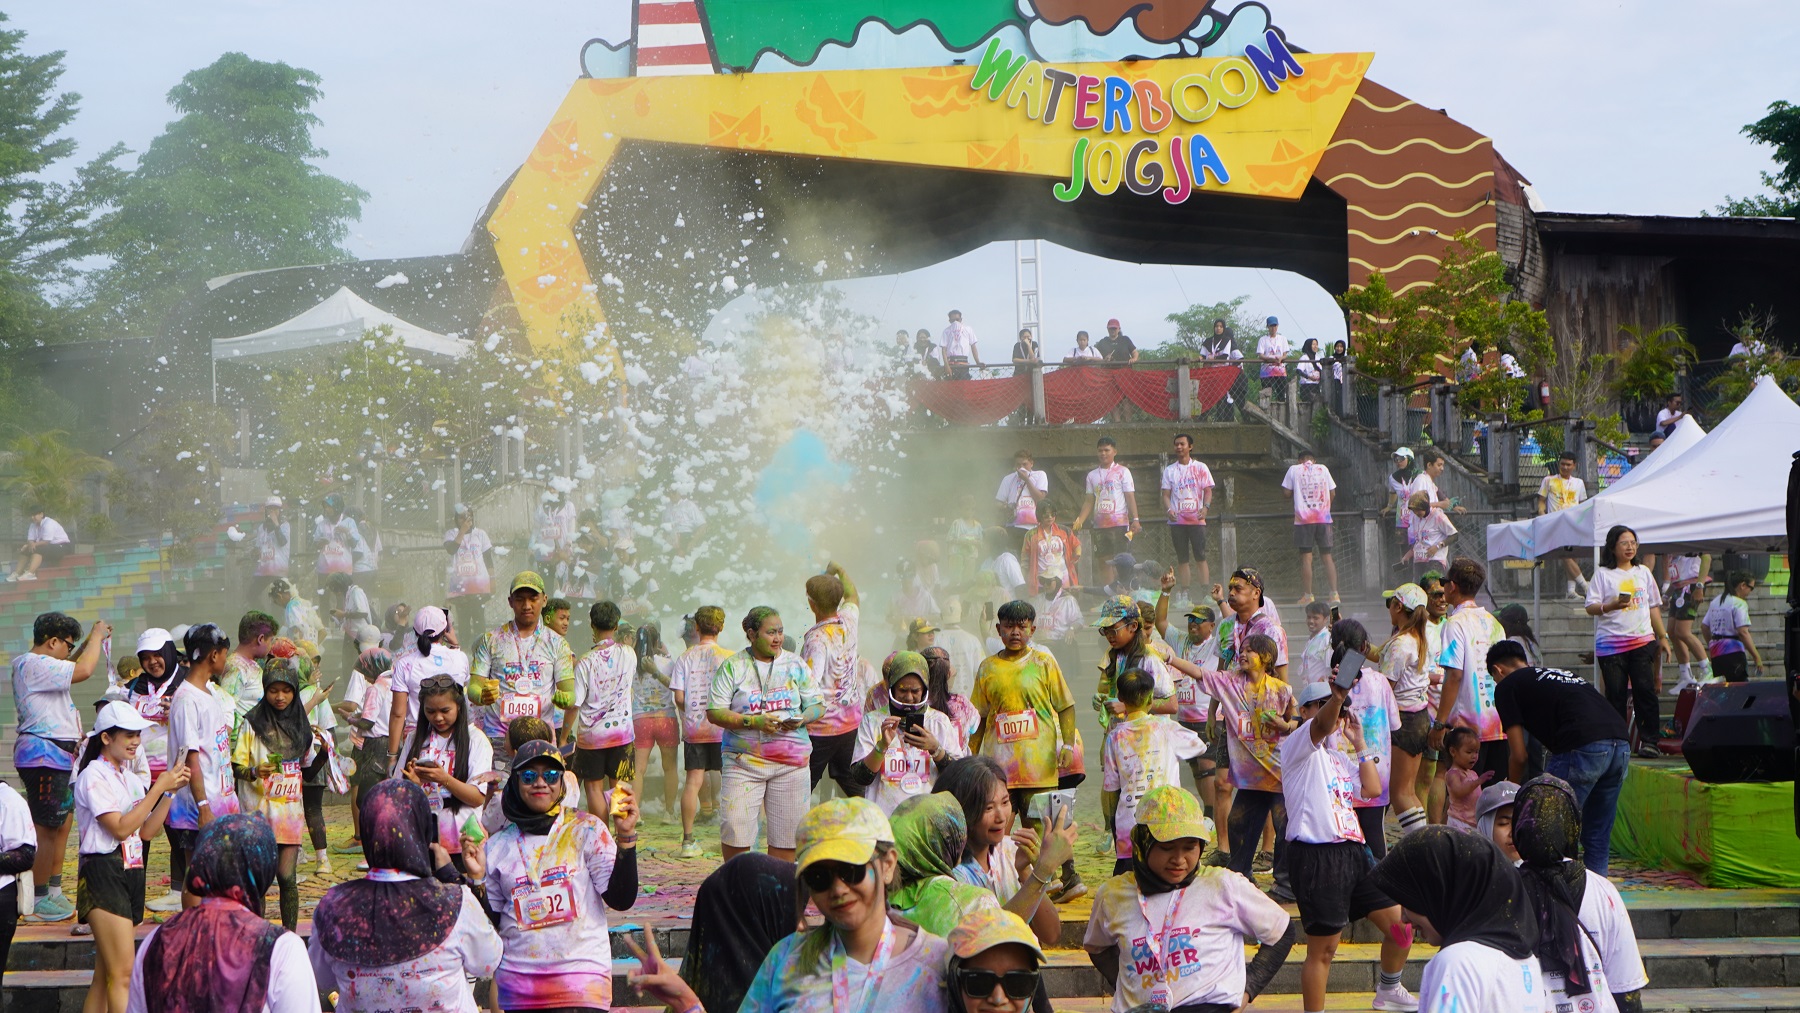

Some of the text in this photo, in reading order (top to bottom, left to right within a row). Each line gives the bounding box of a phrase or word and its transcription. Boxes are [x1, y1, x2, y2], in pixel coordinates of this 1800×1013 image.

[971, 29, 1305, 133] WATERBOOM
[1053, 134, 1230, 205] JOGJA
[505, 672, 541, 681] WAER
[1177, 690, 1191, 699] 013
[508, 702, 535, 716] 0498
[1003, 720, 1029, 735] 0077
[889, 758, 920, 773] 007
[275, 783, 297, 796] 0144
[1131, 934, 1194, 961] COOR
